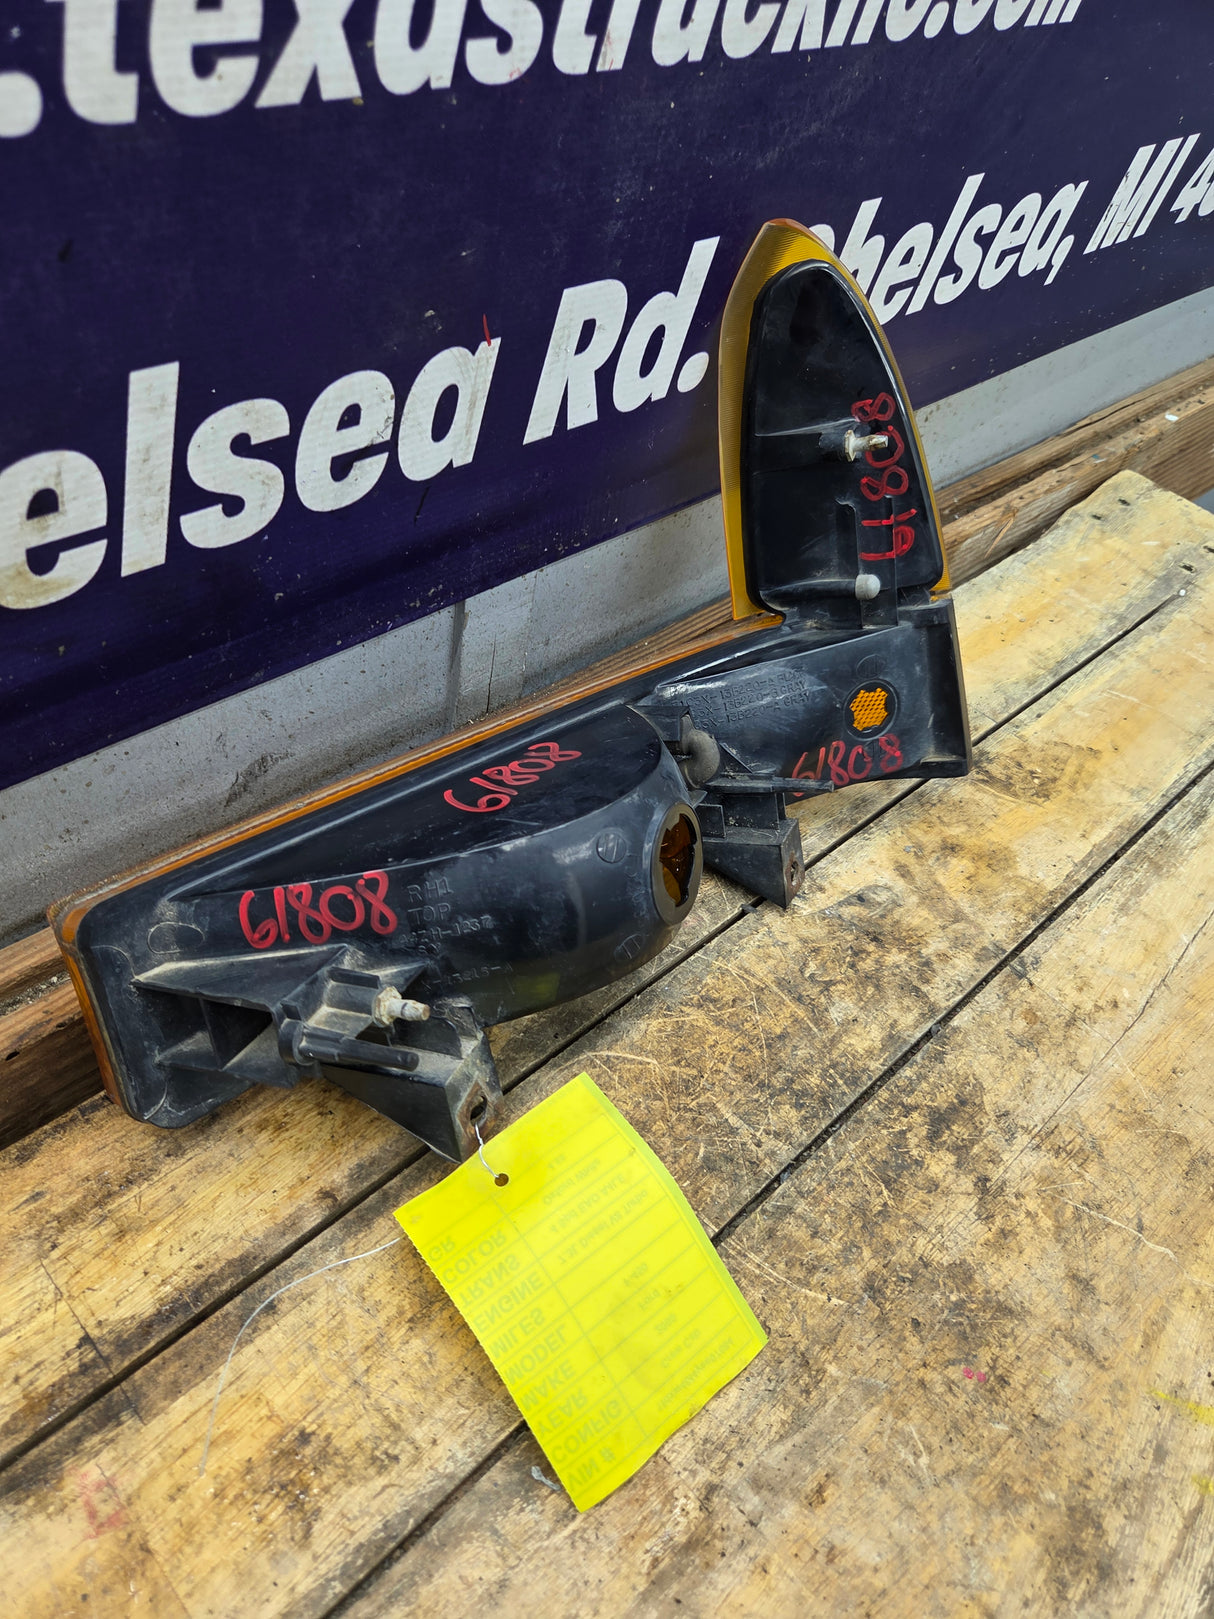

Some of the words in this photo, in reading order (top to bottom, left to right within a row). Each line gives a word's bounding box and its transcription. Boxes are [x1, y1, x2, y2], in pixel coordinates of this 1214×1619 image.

[0, 337, 501, 610] elsea
[523, 236, 720, 445] Rd.
[1083, 133, 1201, 255] MI
[444, 742, 582, 812] 61808
[239, 870, 398, 949] 61808
[408, 902, 451, 925] TOP
